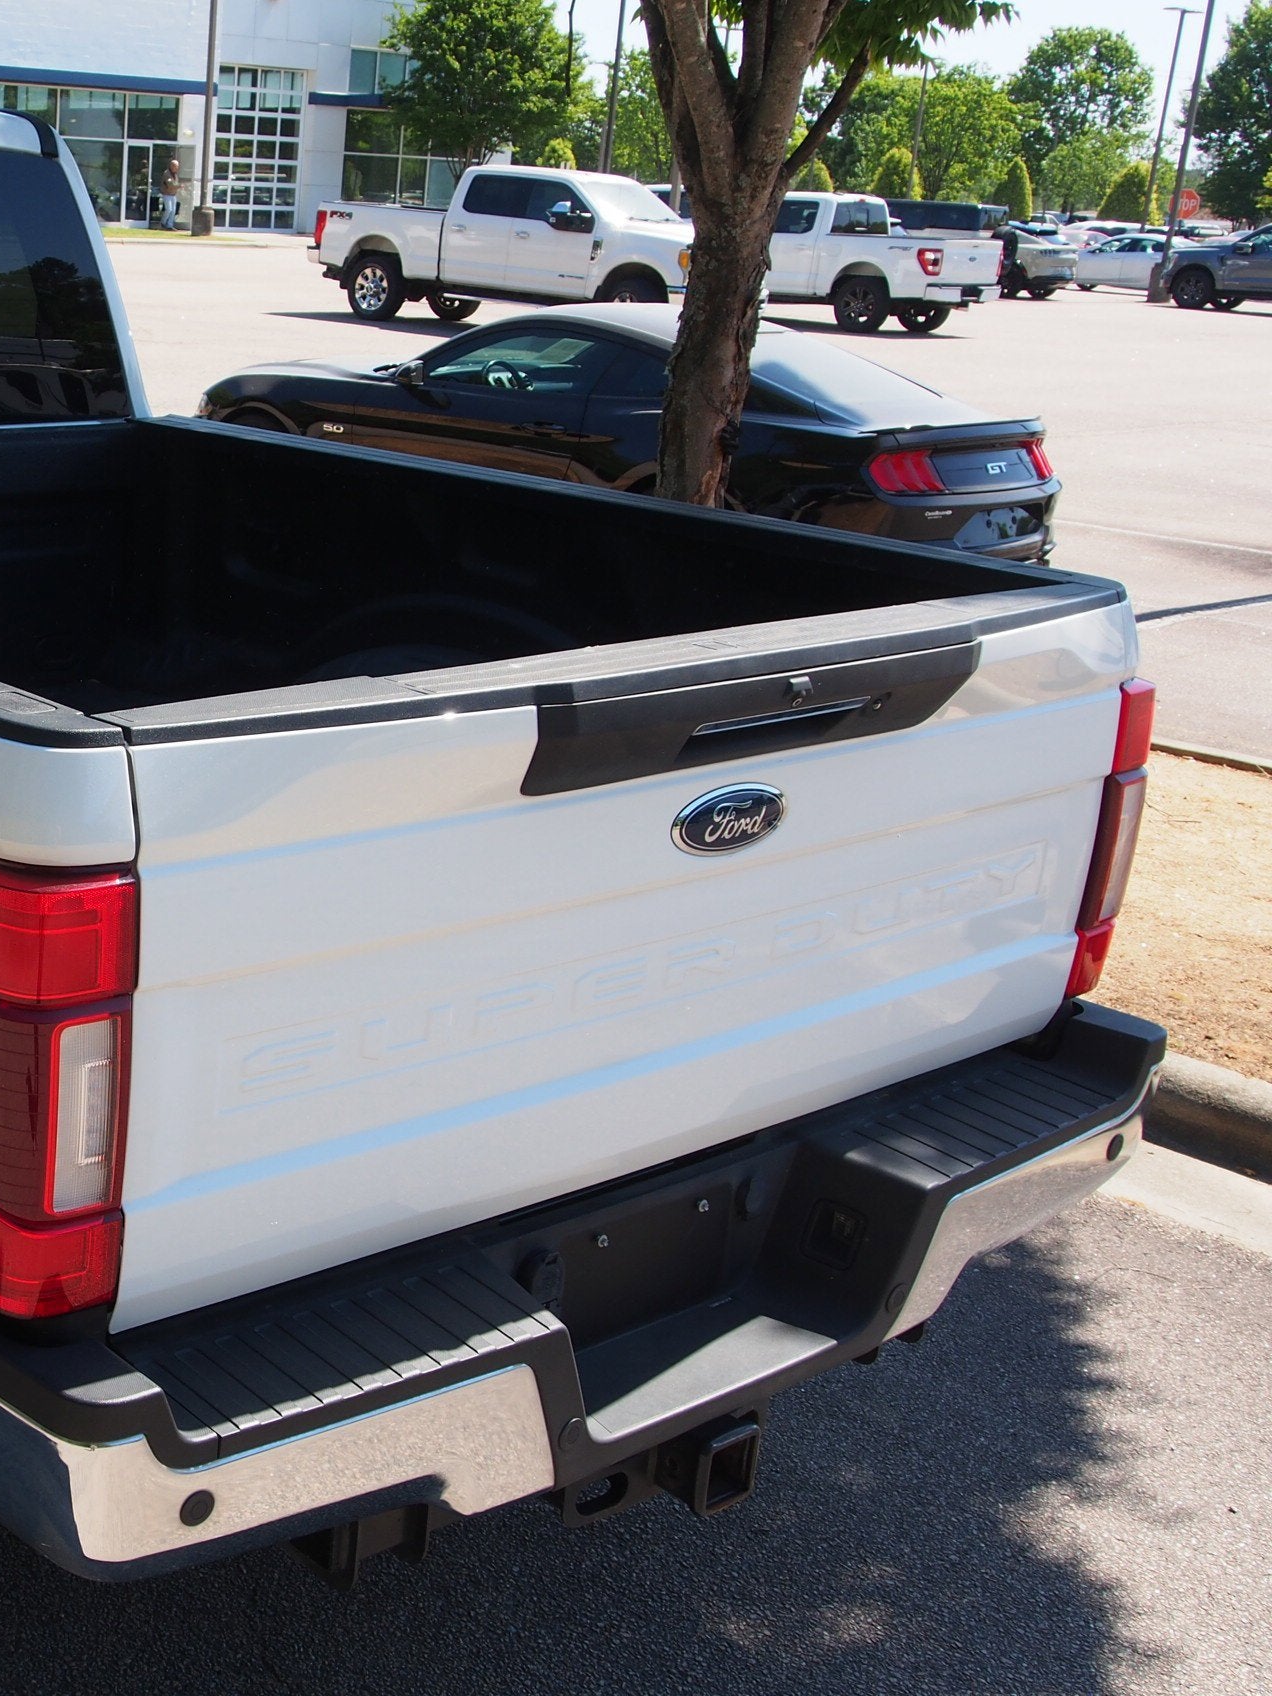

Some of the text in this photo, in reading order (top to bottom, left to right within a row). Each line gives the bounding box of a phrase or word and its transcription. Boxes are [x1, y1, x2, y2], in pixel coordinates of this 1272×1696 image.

[1178, 198, 1197, 211] TOP
[329, 210, 353, 220] FX4
[986, 461, 1007, 475] GT
[704, 799, 767, 843] Ford
[239, 852, 1037, 1094] SUPER DUTY
